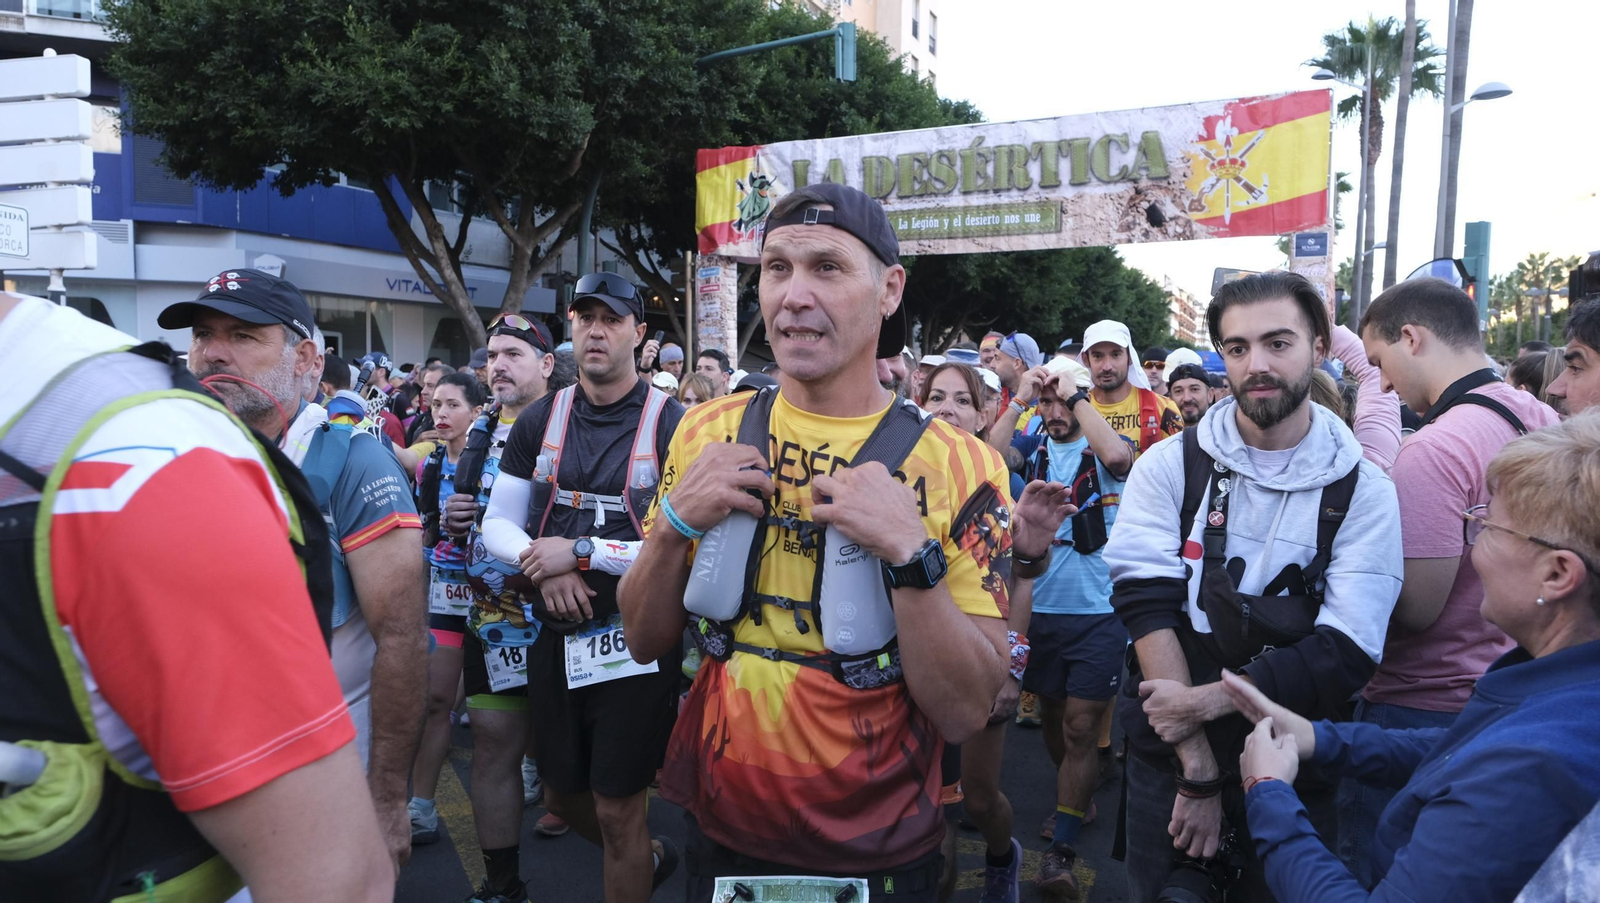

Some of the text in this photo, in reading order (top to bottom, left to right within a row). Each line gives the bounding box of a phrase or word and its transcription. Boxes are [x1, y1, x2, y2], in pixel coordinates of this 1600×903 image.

[863, 131, 1171, 199] DESÉRTICA
[0, 210, 24, 222] IDA
[898, 213, 1041, 231] La Legión y el desierto nos une
[0, 237, 24, 252] ORCA
[386, 277, 478, 299] VITALT
[361, 484, 372, 494] LA
[363, 495, 374, 503] EL
[375, 496, 389, 508] NOS
[782, 500, 802, 512] CLUB
[835, 551, 869, 567] Kalenji
